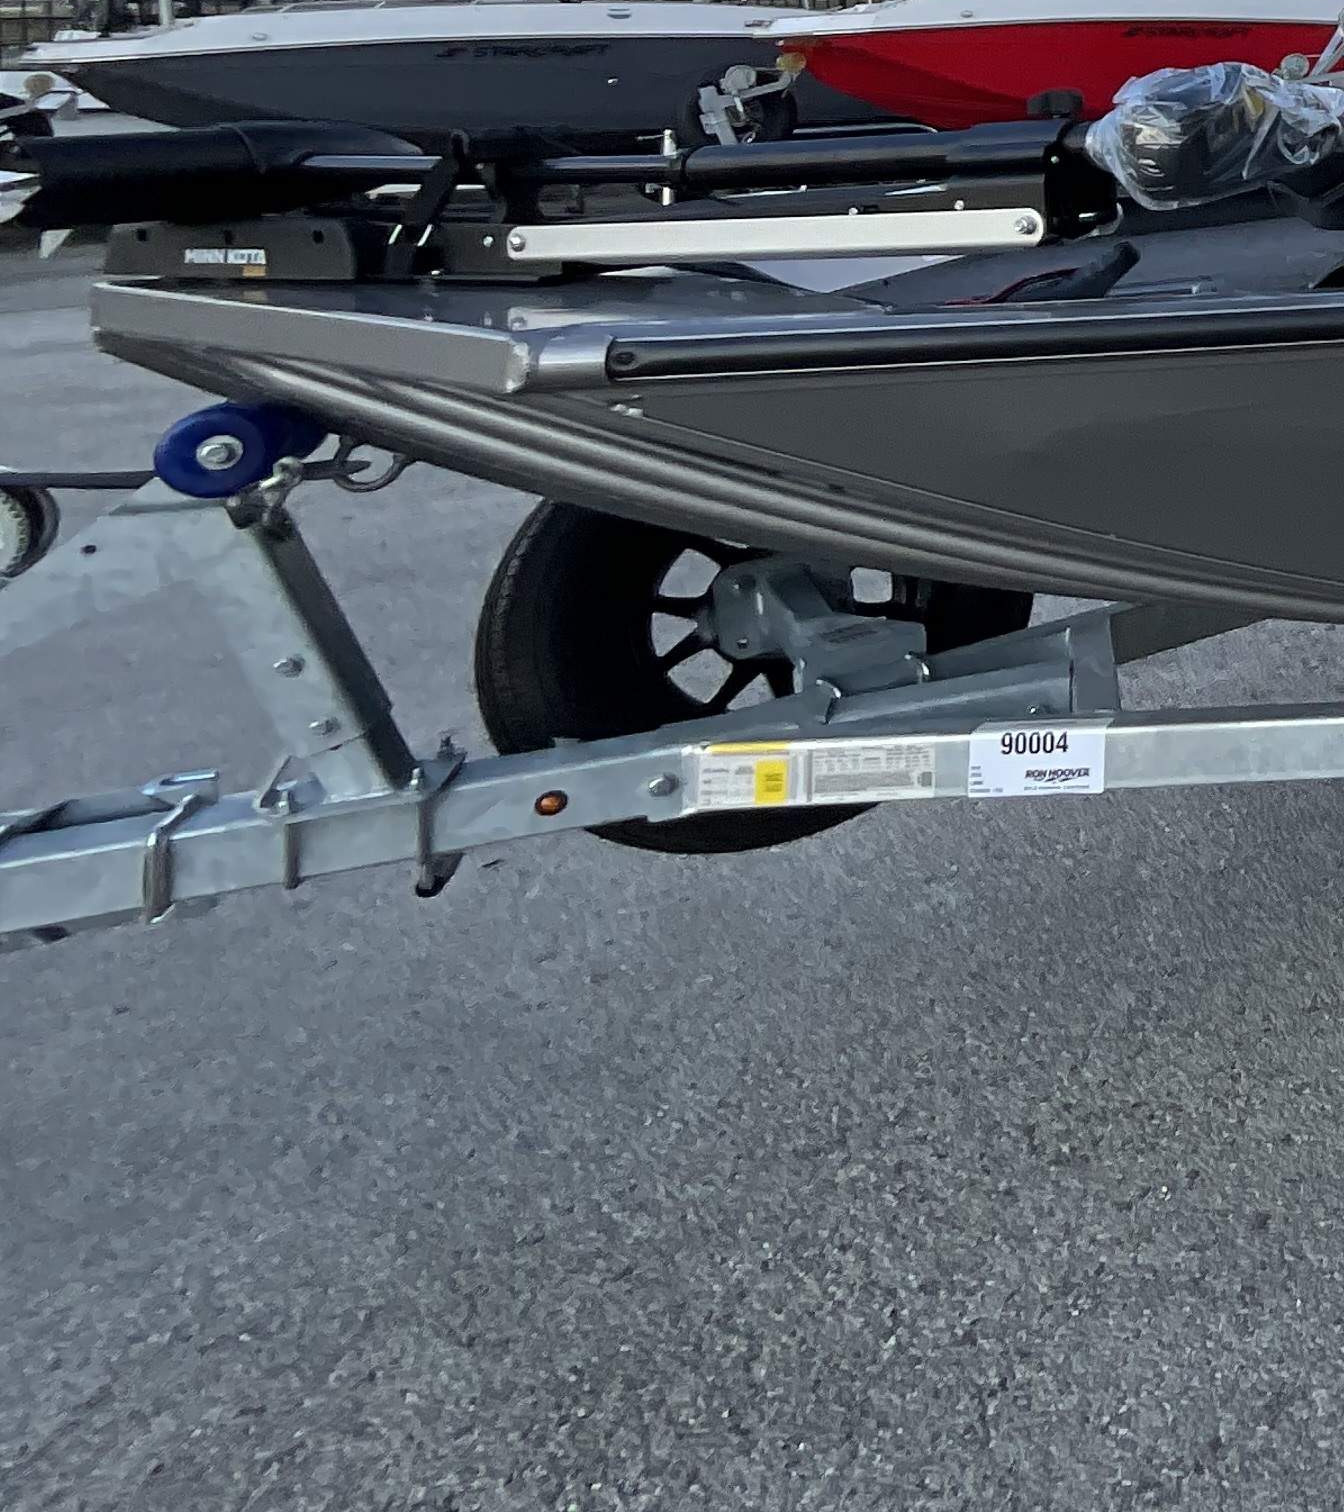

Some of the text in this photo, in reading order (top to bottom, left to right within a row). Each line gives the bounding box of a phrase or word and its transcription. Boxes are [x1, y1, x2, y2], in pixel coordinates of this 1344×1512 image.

[1001, 731, 1069, 755] 90004
[1024, 768, 1091, 779] RON HOOVER
